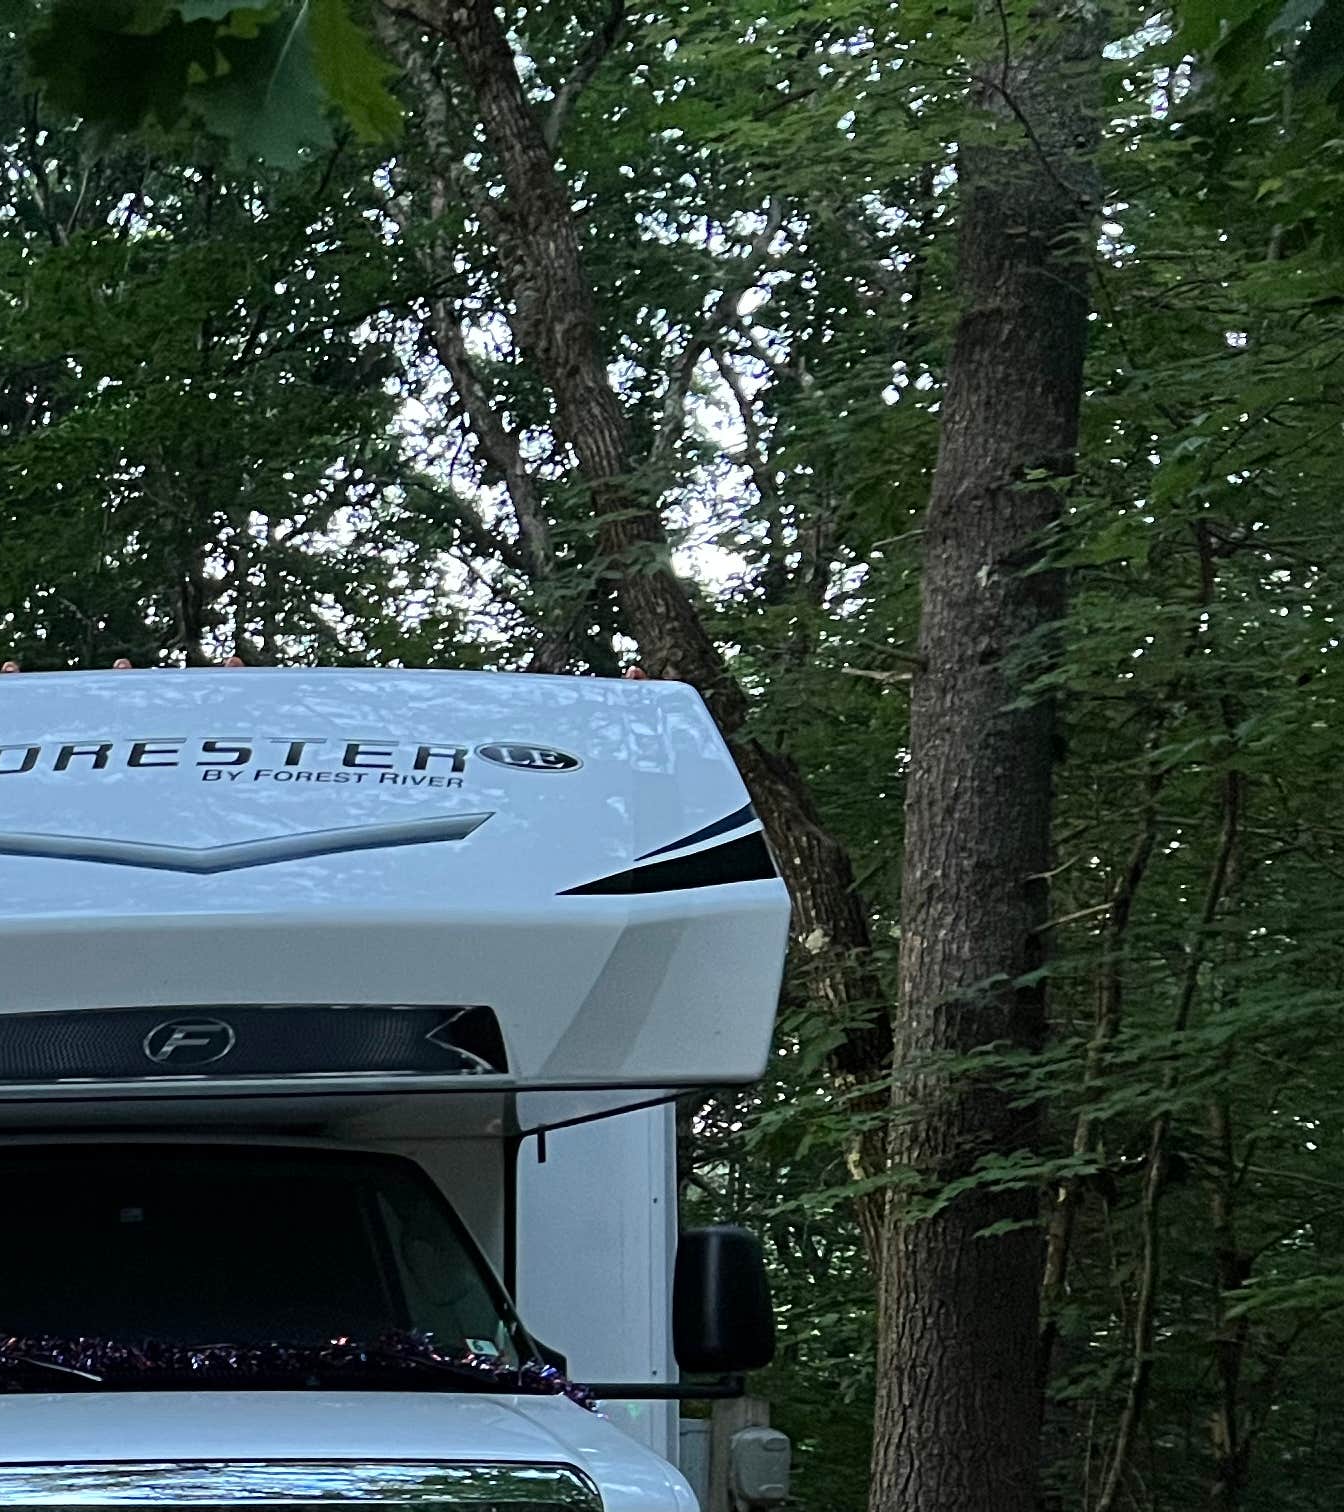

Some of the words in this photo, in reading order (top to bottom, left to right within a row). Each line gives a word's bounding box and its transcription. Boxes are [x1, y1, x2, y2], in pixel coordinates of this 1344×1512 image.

[498, 746, 566, 769] LE
[201, 769, 244, 782] BY
[253, 769, 369, 784] FOREST
[378, 772, 464, 788] RIVER
